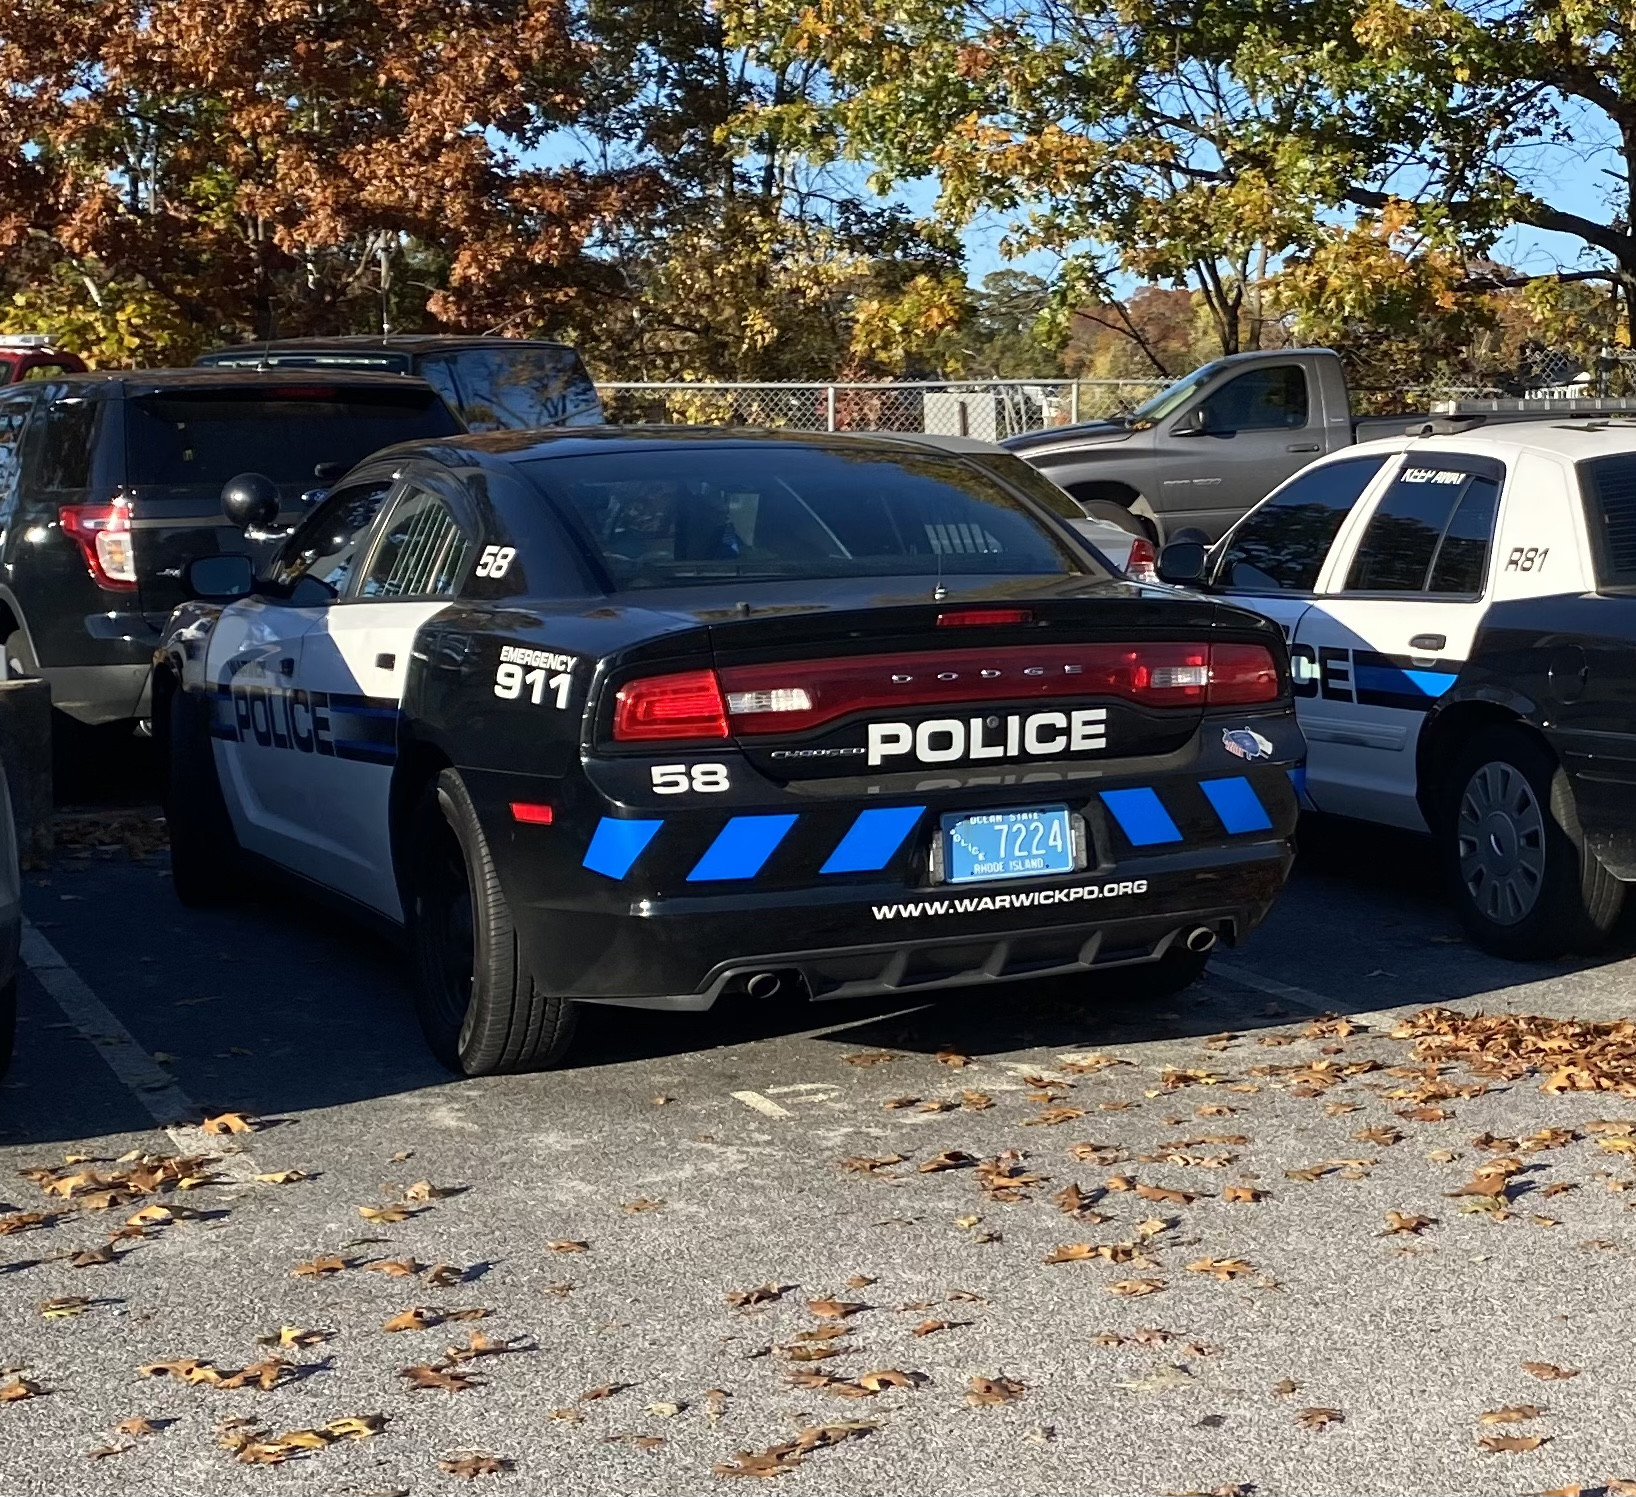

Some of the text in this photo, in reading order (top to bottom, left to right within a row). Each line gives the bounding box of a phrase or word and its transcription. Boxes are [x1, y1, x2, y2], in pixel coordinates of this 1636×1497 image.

[1401, 468, 1436, 483] KEEP
[475, 545, 516, 578] 58
[1504, 547, 1550, 573] R81
[500, 646, 577, 671] EMERGENCY
[891, 664, 1083, 684] DODGE
[494, 662, 571, 709] 911
[233, 685, 335, 757] POLICE
[867, 708, 1107, 766] POLICE
[650, 763, 730, 795] 58
[970, 813, 1040, 825] OCEAN STATE
[994, 819, 1063, 859] 7224
[974, 858, 1044, 874] RHODE ISLAND
[872, 880, 1147, 920] WWW.WARWICKPD.ORG
